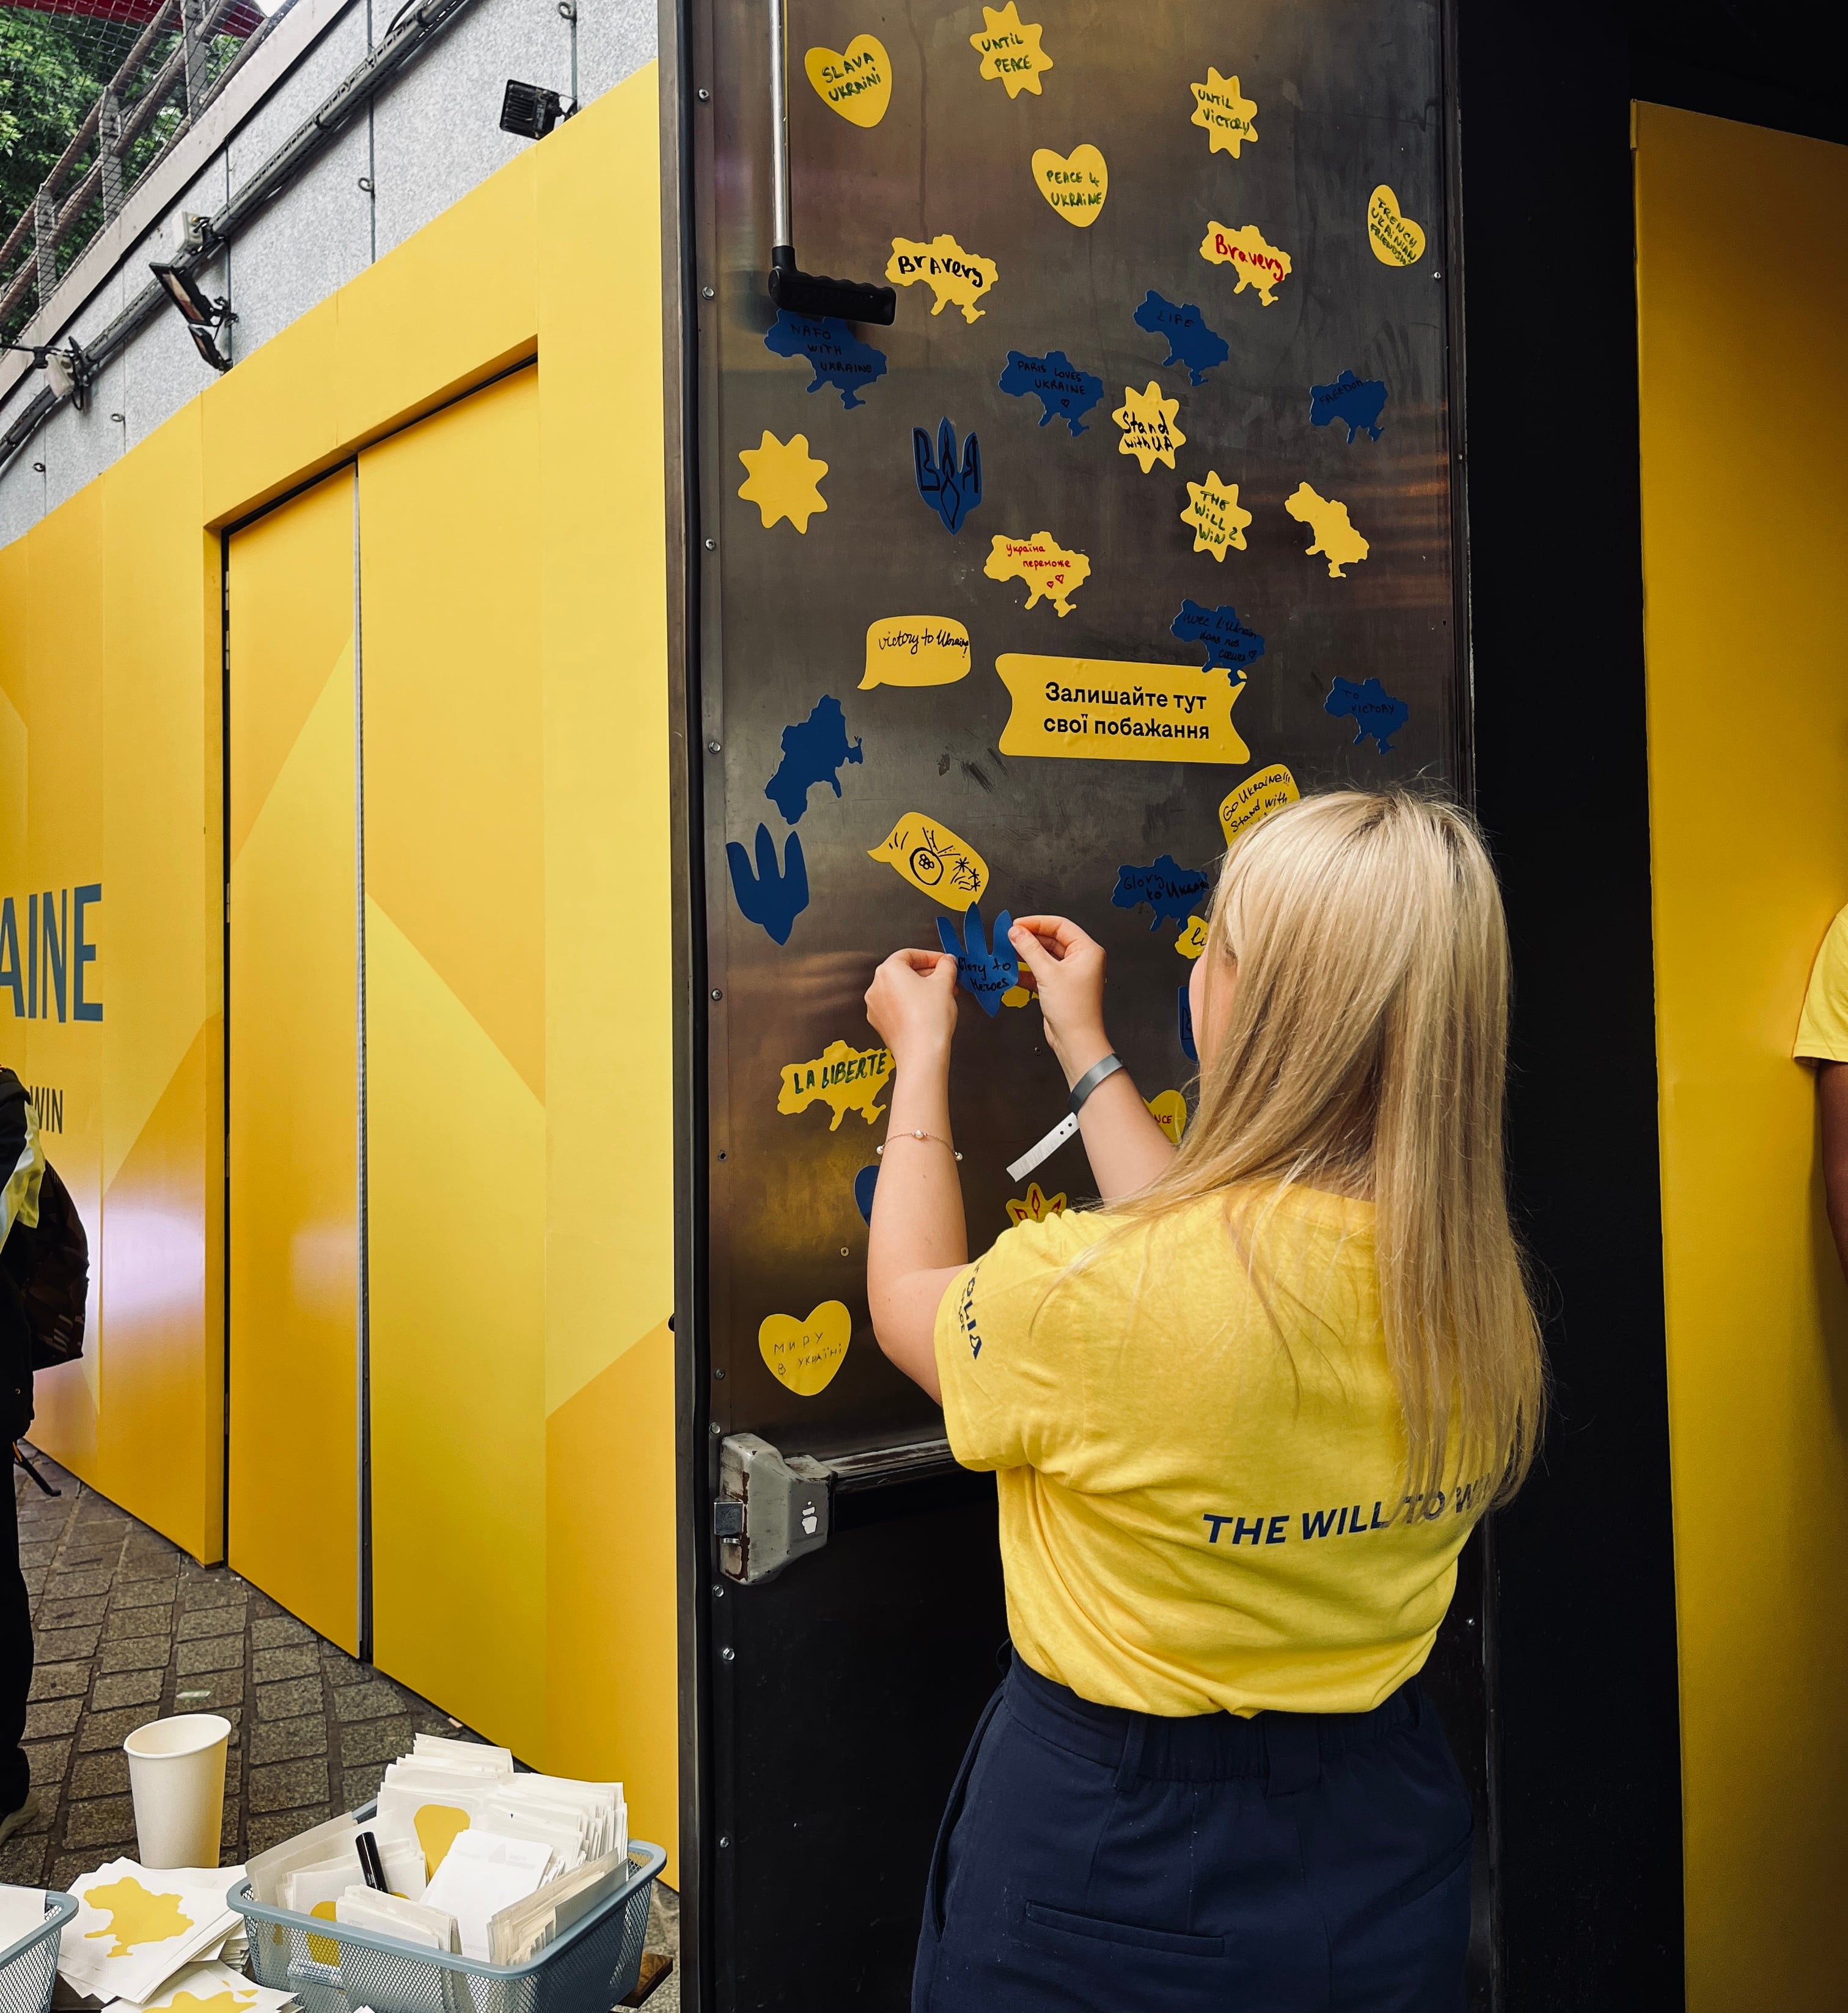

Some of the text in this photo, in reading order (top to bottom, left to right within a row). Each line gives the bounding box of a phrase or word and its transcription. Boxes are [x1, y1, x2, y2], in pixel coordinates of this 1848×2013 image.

[822, 53, 874, 82] SLAVA
[994, 54, 1032, 72] PEACE
[1046, 170, 1099, 187] PEACE 4
[1157, 310, 1195, 327] LIFE
[807, 343, 842, 356] WITH
[820, 361, 872, 373] UKRAINE
[1018, 361, 1082, 382] PARIS LOVES
[1035, 379, 1085, 395] UKRAINE
[1123, 410, 1169, 435] Stand
[1200, 491, 1230, 511] THE
[1007, 543, 1046, 557] Україна
[1023, 560, 1071, 570] переможе
[921, 628, 934, 646] to
[1045, 681, 1206, 714] Залишайте тут
[1341, 689, 1358, 699] TO
[1351, 703, 1395, 716] VICTORY
[1043, 714, 1210, 739] свої побажання
[1124, 874, 1165, 890] Glory
[1146, 887, 1162, 901] to
[992, 958, 1011, 970] to
[794, 1069, 815, 1094] LA
[1203, 1514, 1289, 1545] THE
[1302, 1501, 1390, 1541] WILL
